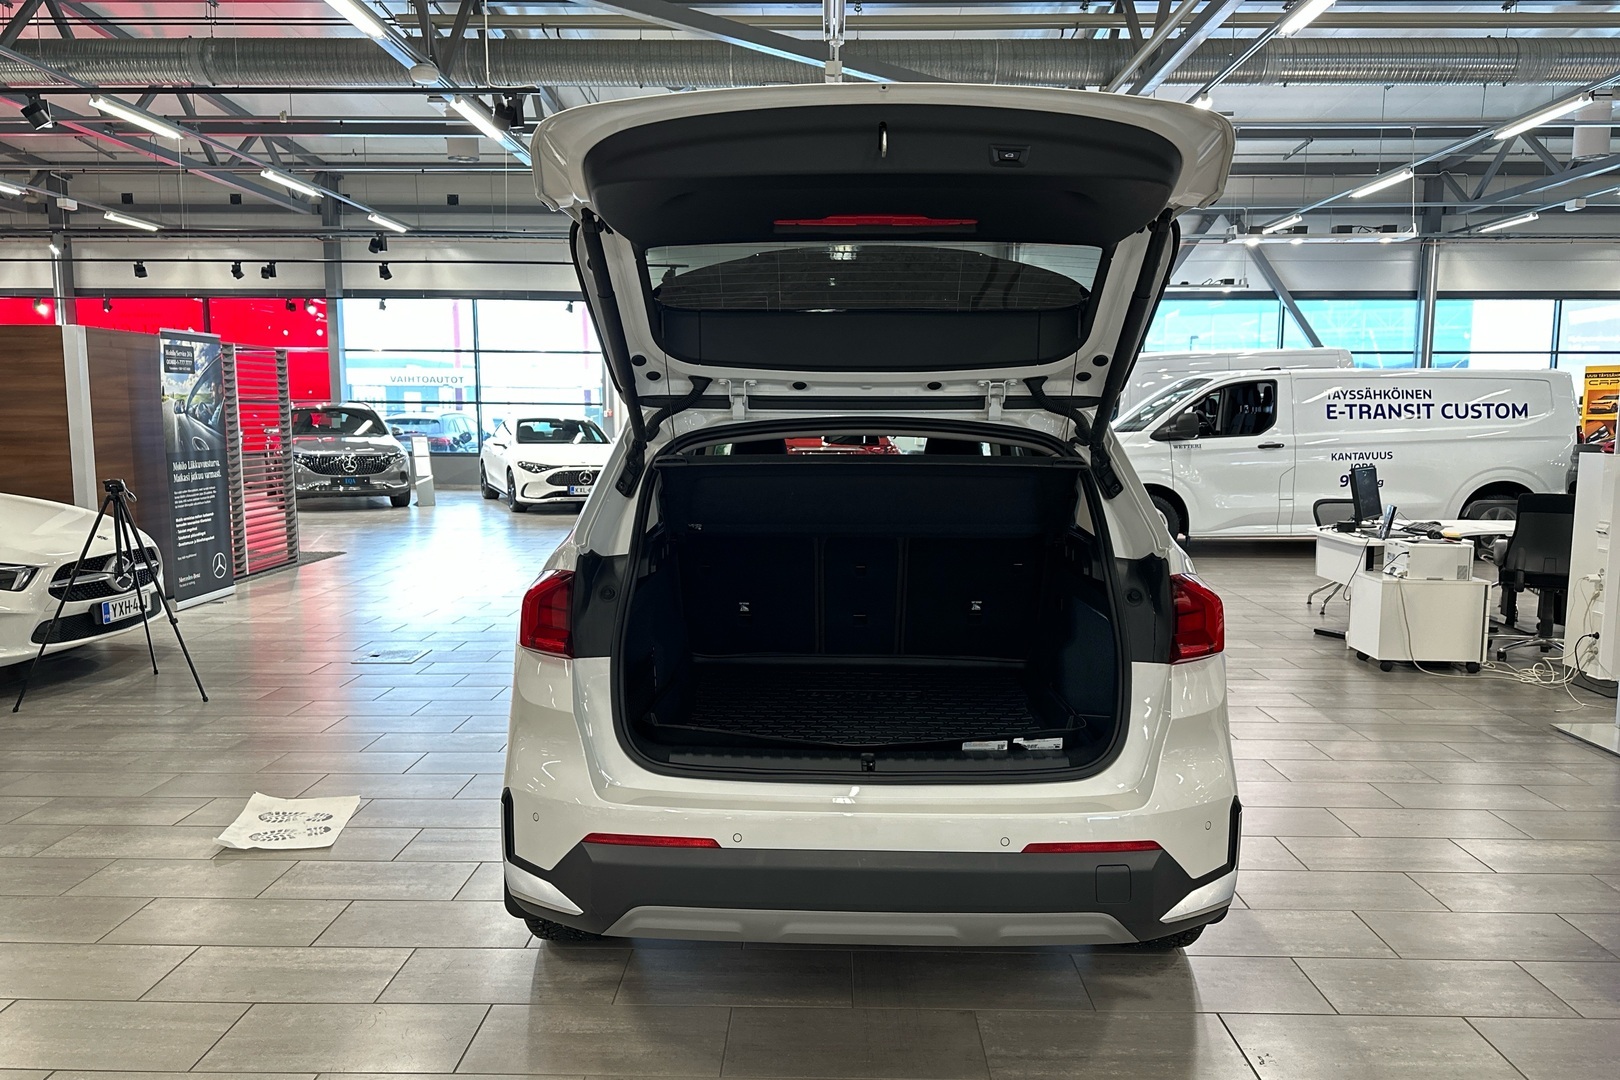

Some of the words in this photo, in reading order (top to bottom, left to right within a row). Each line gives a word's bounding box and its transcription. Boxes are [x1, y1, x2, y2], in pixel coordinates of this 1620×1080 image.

[1326, 403, 1435, 419] E-TRANSIT
[1441, 403, 1528, 419] CUSTOM
[1331, 451, 1393, 461] KANTAVUUS
